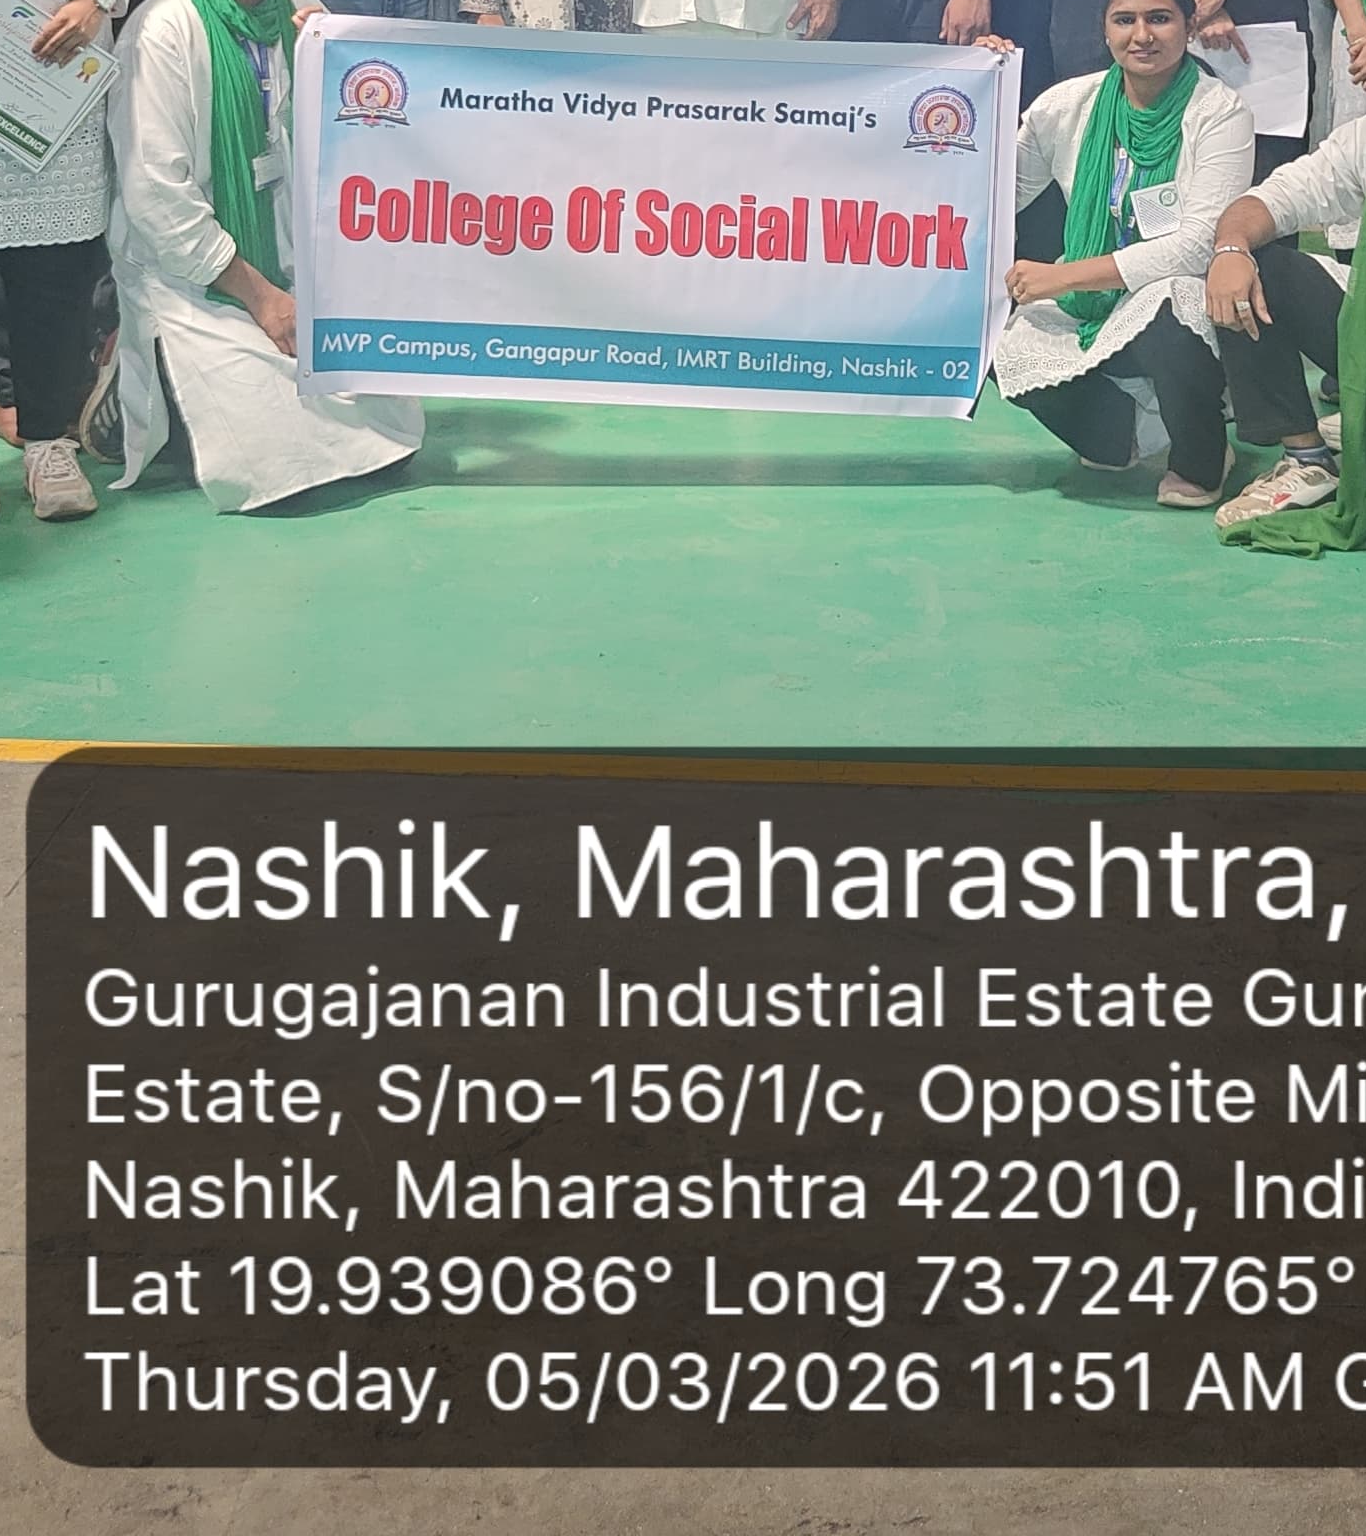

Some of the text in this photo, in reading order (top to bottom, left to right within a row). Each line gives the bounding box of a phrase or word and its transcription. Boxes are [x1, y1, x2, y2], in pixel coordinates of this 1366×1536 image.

[440, 87, 877, 133] Maratha Vidya Prasarak Samaj's
[338, 175, 968, 270] College Of Social Work
[321, 333, 372, 353] MVP
[378, 334, 477, 361] Campus,
[485, 338, 600, 366] Gangapur
[606, 344, 669, 370] Road,
[677, 349, 731, 370] IMRT
[738, 351, 834, 379] Building,
[842, 356, 918, 378] Nashik
[942, 360, 970, 380] 02
